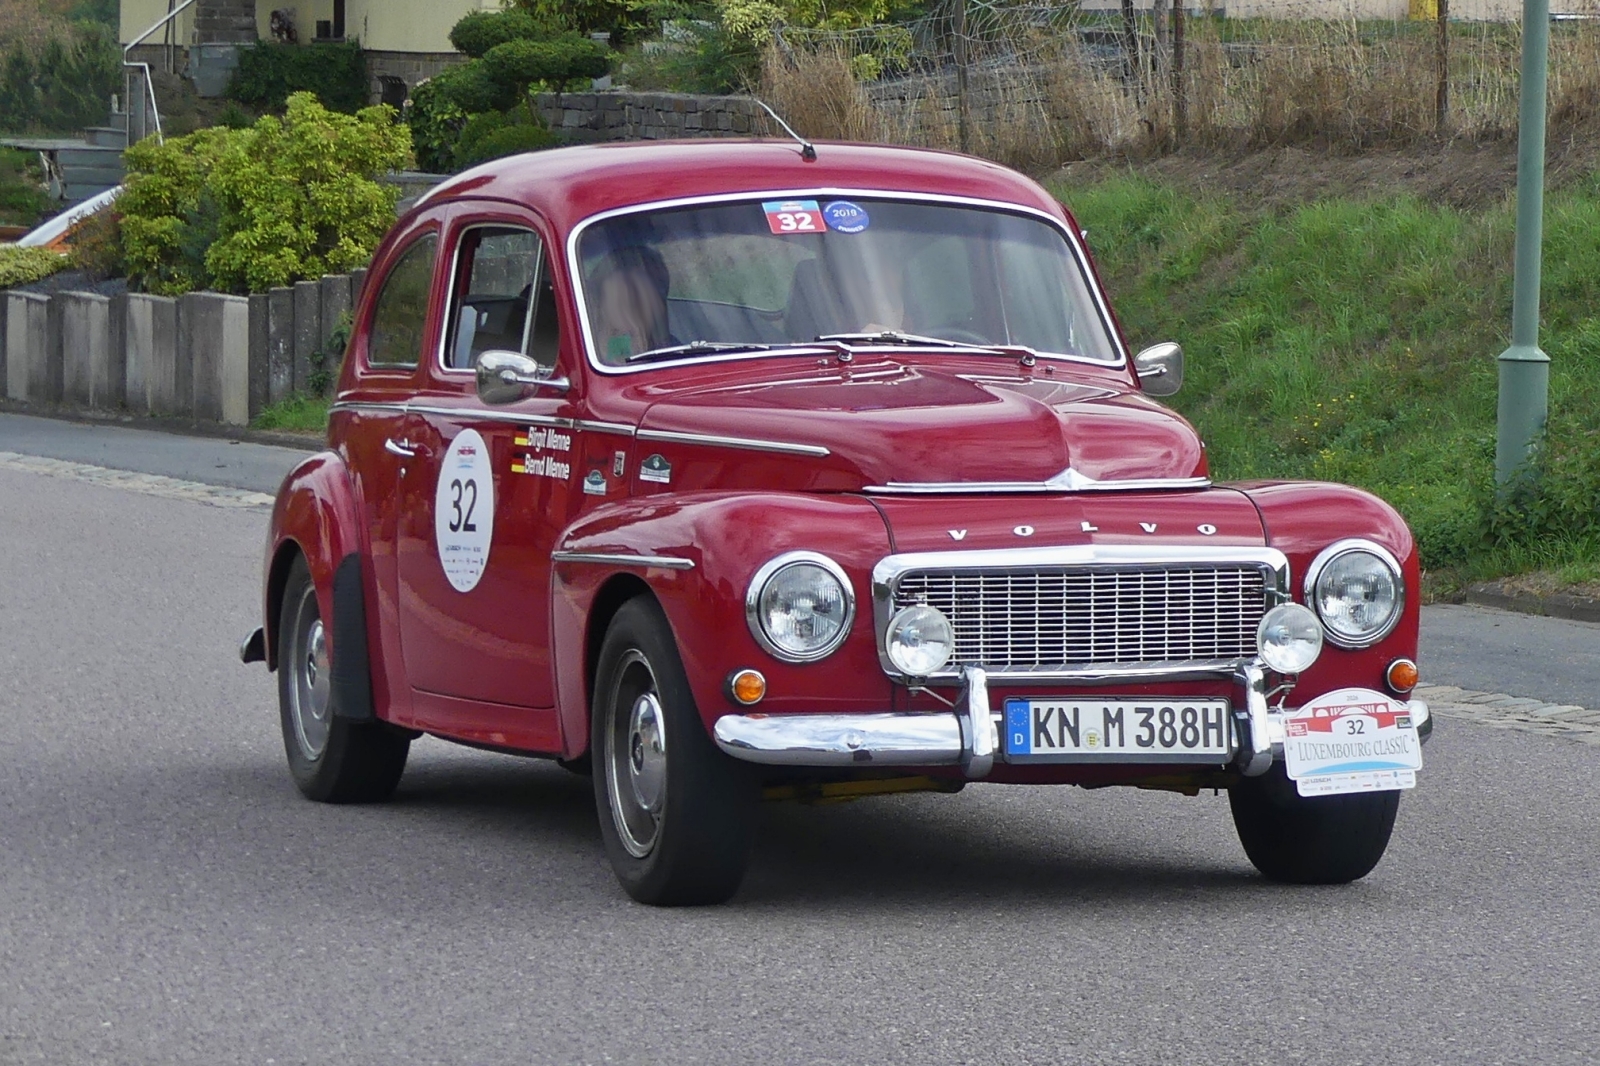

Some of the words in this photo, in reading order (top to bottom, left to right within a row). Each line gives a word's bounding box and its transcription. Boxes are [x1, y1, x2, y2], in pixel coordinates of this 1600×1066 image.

[777, 212, 816, 231] 32
[528, 426, 547, 452] Birgit
[546, 428, 571, 451] Menne
[525, 453, 546, 476] Bernd
[545, 456, 570, 480] Menne
[449, 478, 477, 533] 32
[947, 521, 1218, 541] VOLVO
[1014, 734, 1024, 745] D
[1033, 707, 1080, 748] KN
[1103, 707, 1125, 748] M
[1134, 707, 1224, 748] 388H
[1346, 719, 1365, 735] 32
[1297, 741, 1371, 762] LUXEMBOURG
[1373, 735, 1410, 756] CLASSIC
